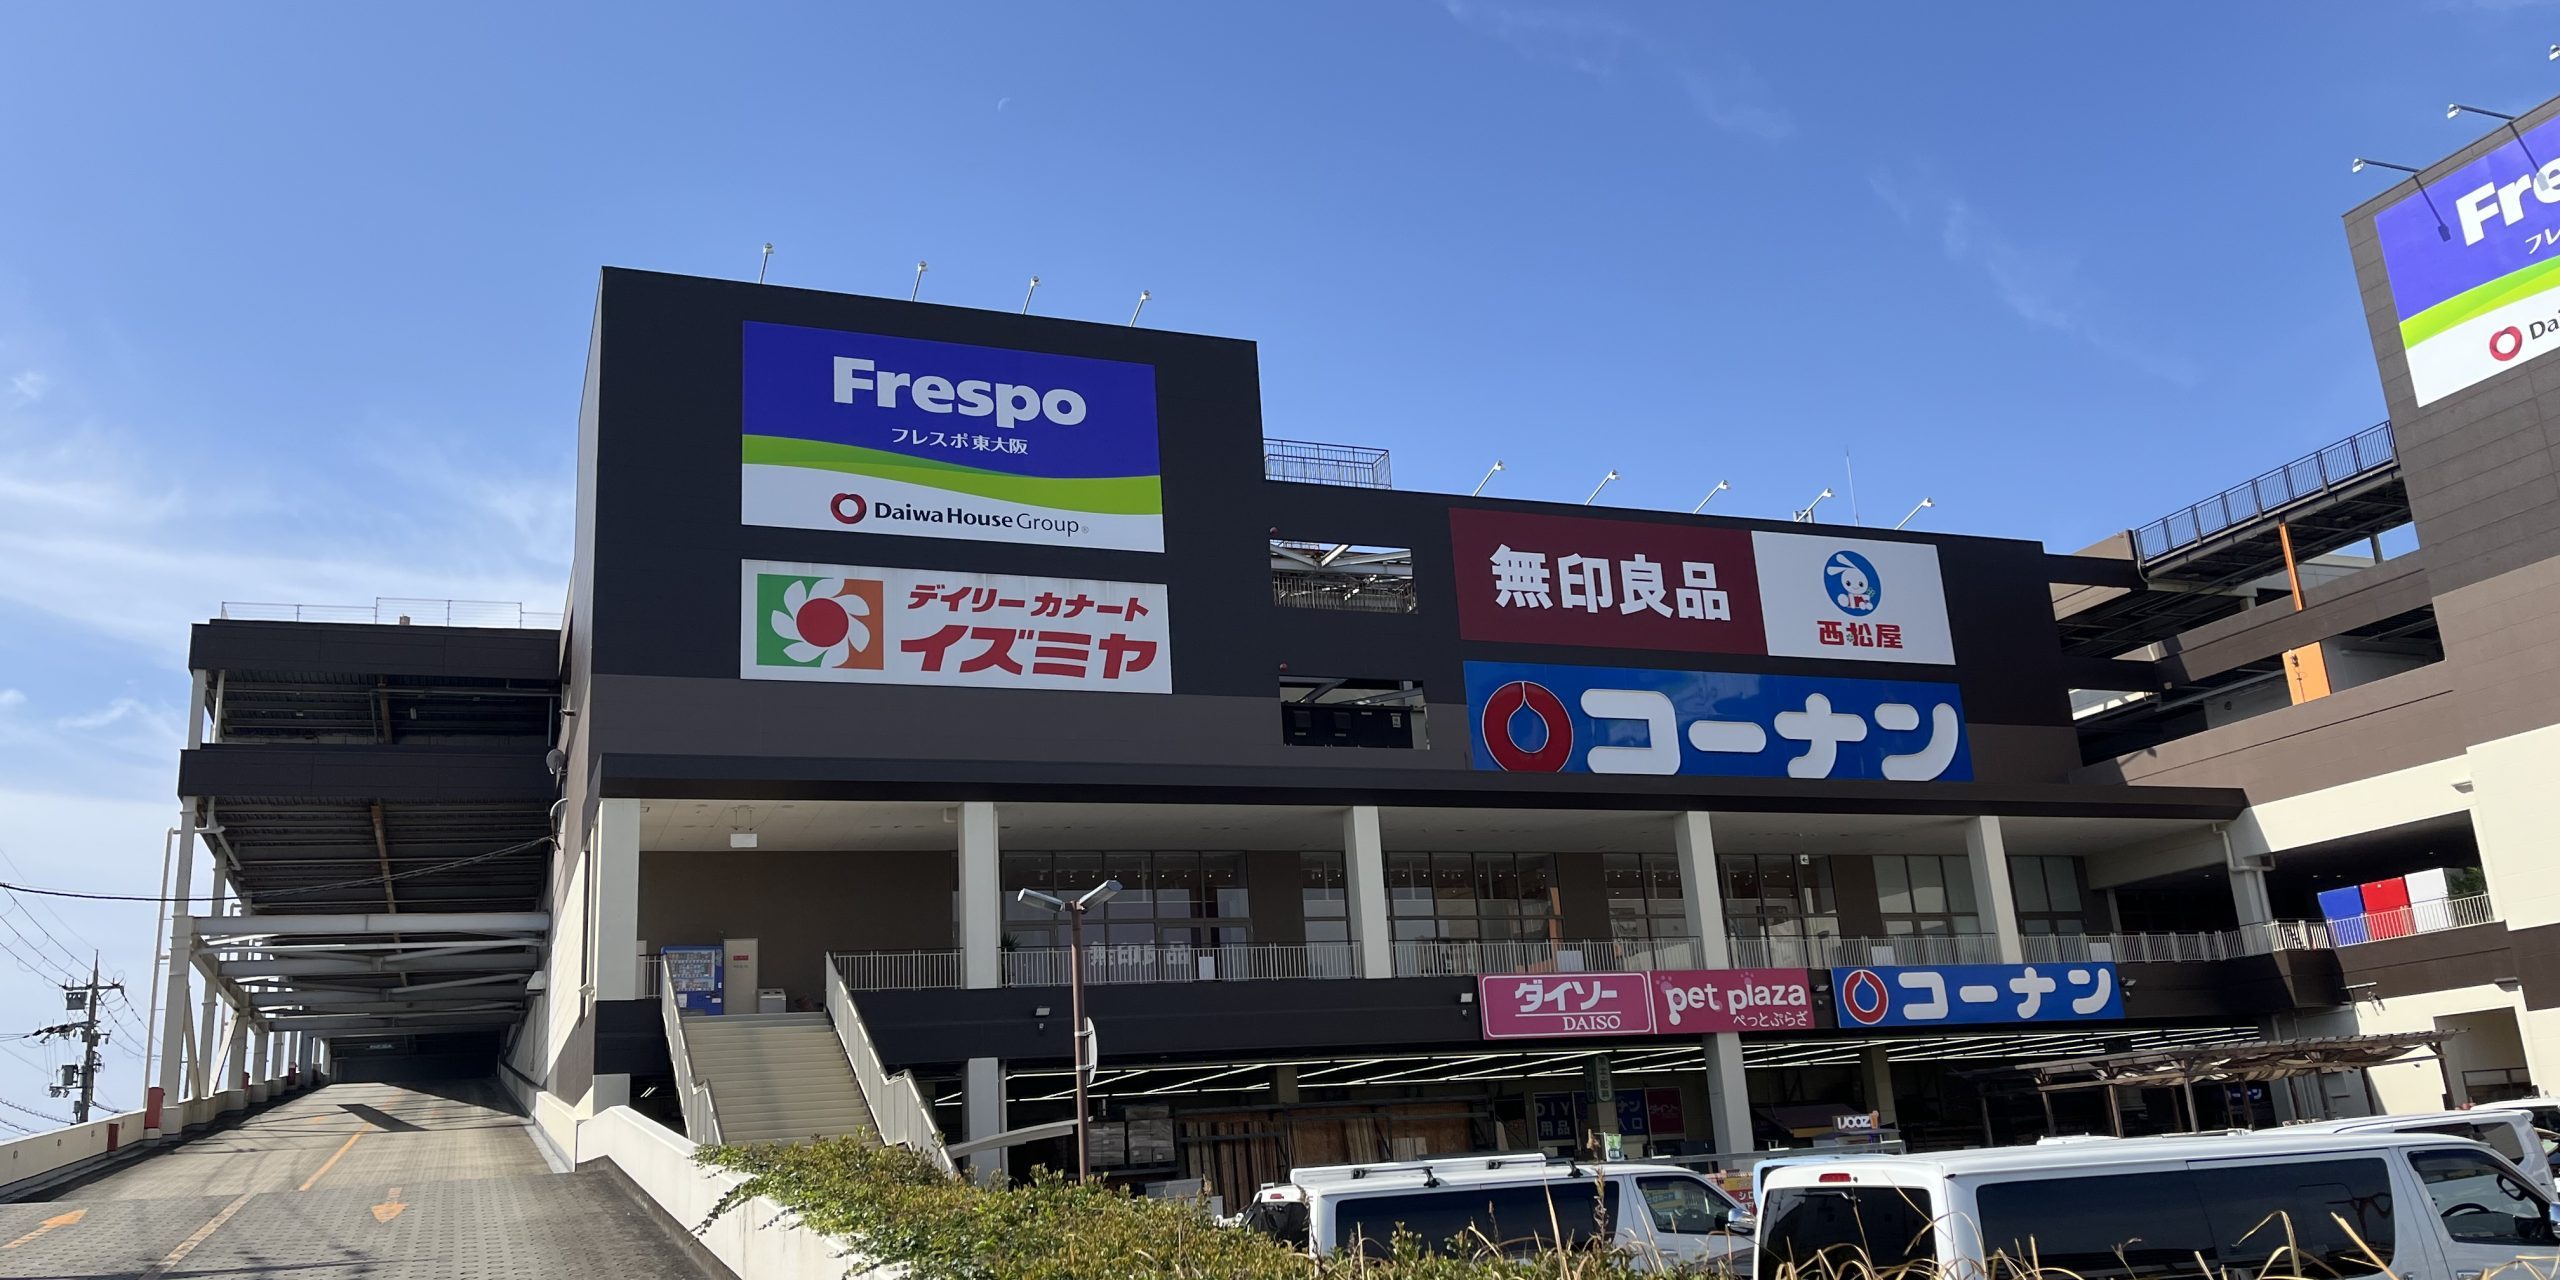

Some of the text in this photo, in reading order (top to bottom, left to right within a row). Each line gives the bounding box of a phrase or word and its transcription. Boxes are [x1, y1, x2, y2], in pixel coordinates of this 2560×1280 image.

[833, 355, 1087, 428] Frespo
[891, 427, 1029, 455] フレスポ東大阪
[874, 502, 1079, 537] Daiwa House Group
[1490, 543, 1731, 621] 無印良品
[900, 624, 1158, 679] イズミヤ
[1816, 620, 1904, 649] 西松屋
[1580, 688, 1959, 782] コーナン
[1514, 979, 1618, 1012] ダイソー
[1665, 980, 1806, 1026] pet plaza
[1898, 966, 2112, 1019] コーナン
[1562, 1015, 1621, 1031] DAISO
